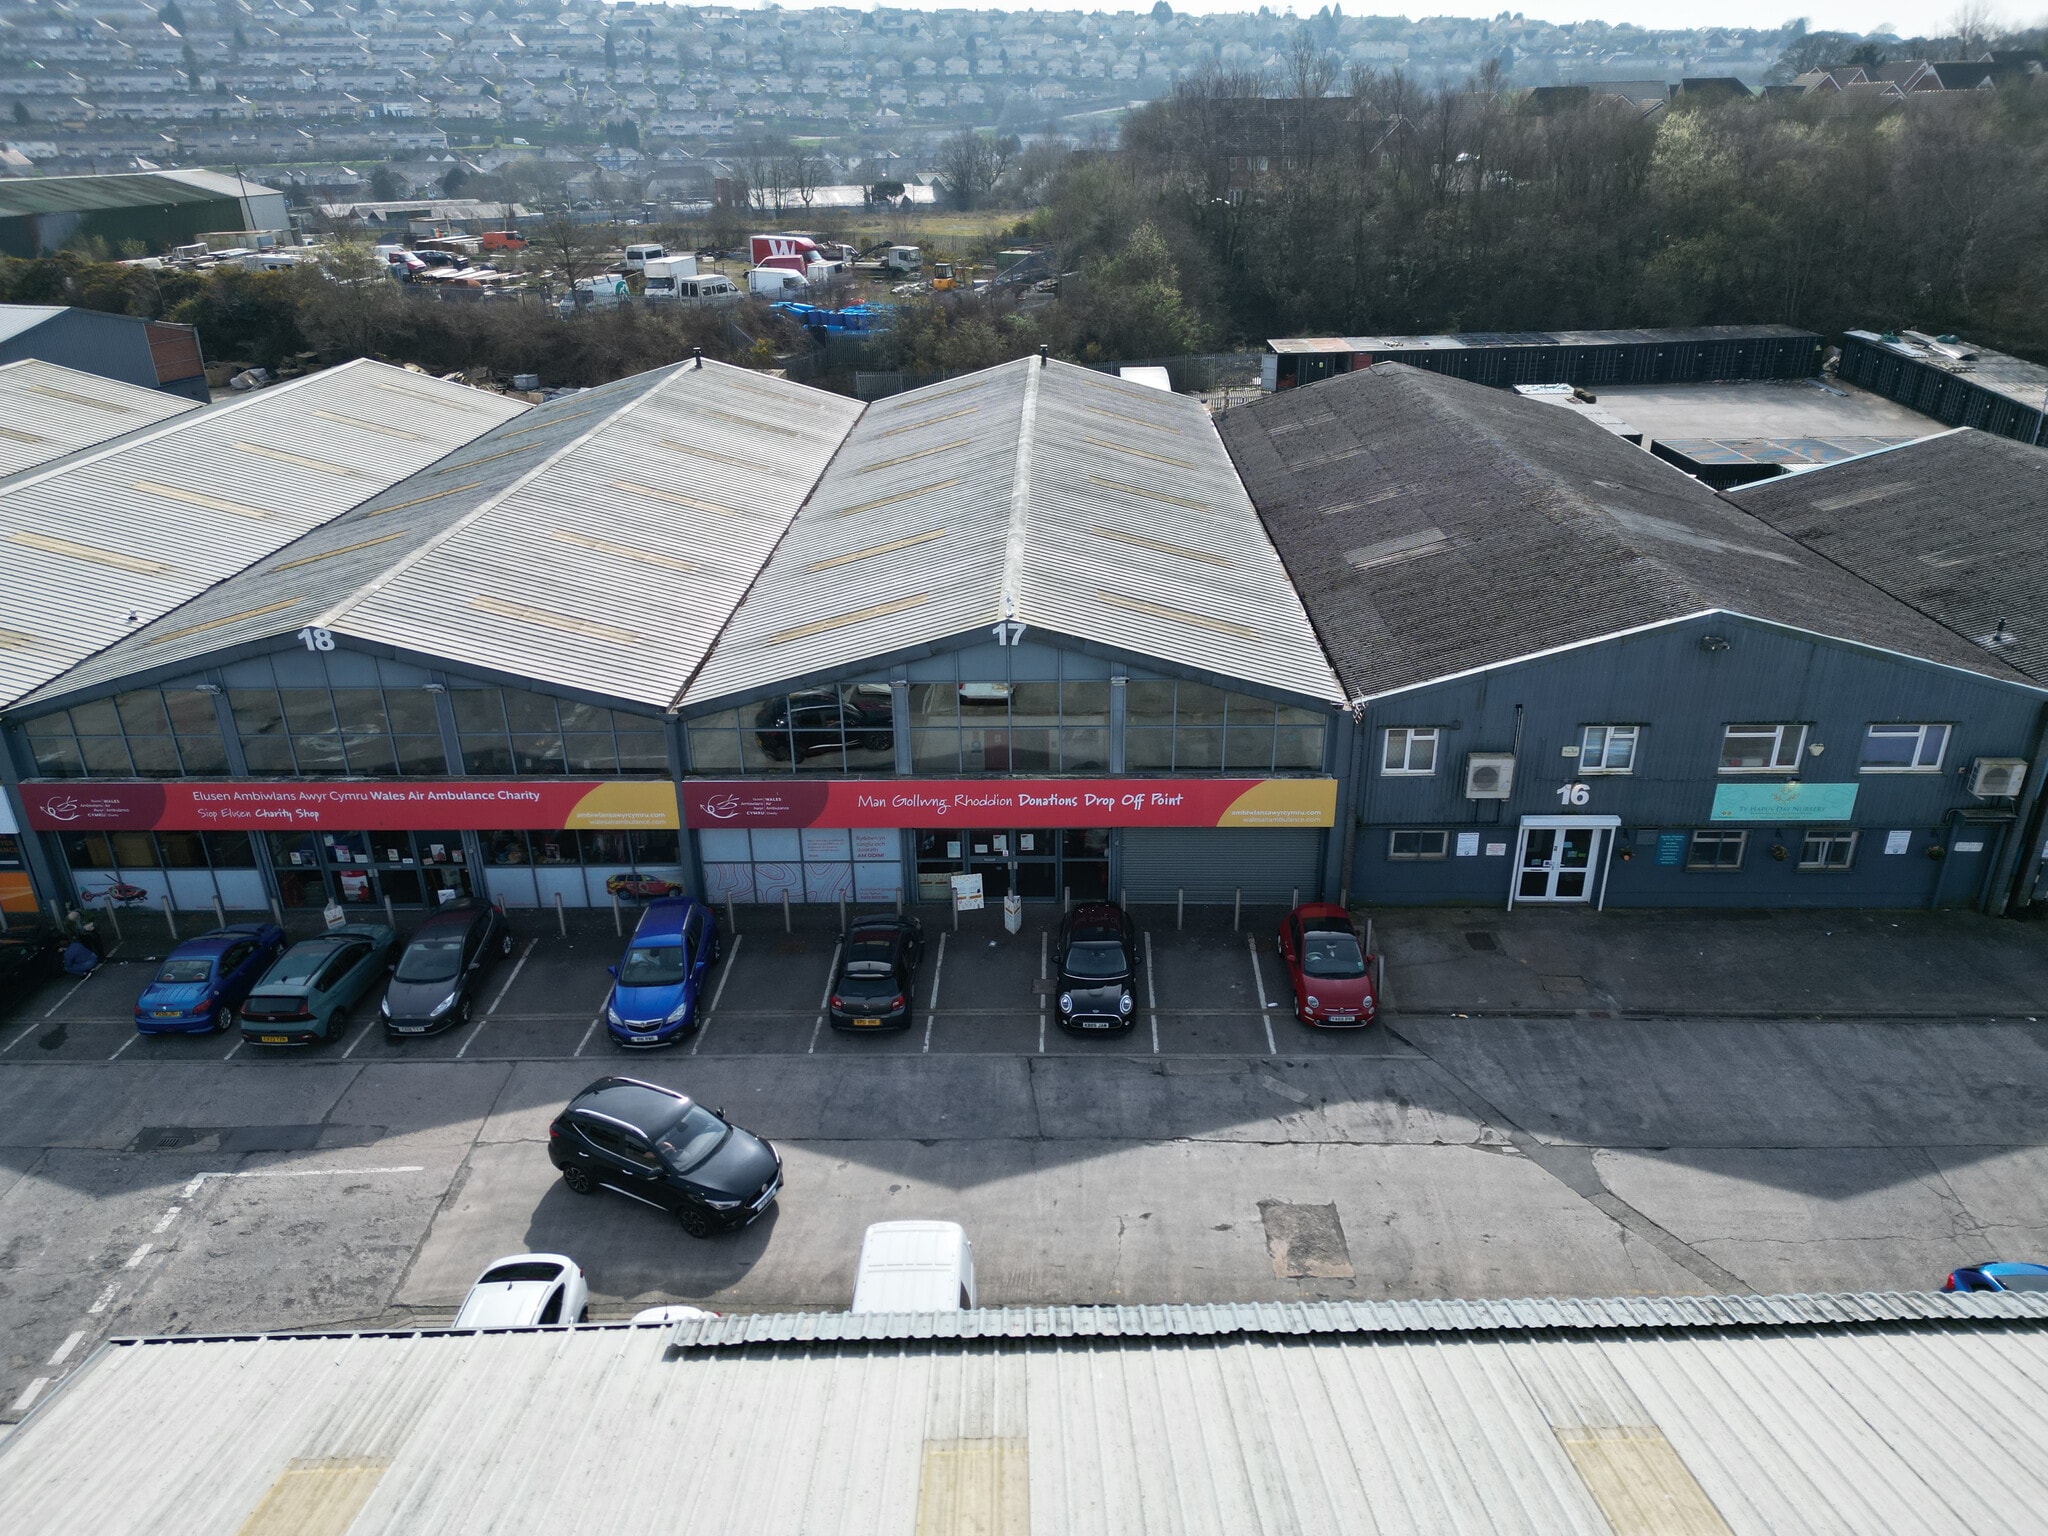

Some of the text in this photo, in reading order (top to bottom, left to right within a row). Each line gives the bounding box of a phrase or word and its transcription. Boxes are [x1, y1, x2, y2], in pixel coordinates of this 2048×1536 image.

[297, 628, 336, 651] 18
[992, 623, 1027, 646] 17
[192, 790, 540, 803] Elusen Ambiwlans Awyr Cymru Wales Air Ambulance Charity
[857, 793, 1184, 815] Man Gollwng Rhoddion Donations Drop Off Point
[1556, 783, 1590, 806] 16
[197, 808, 320, 822] Siop Elusen Charity Shop
